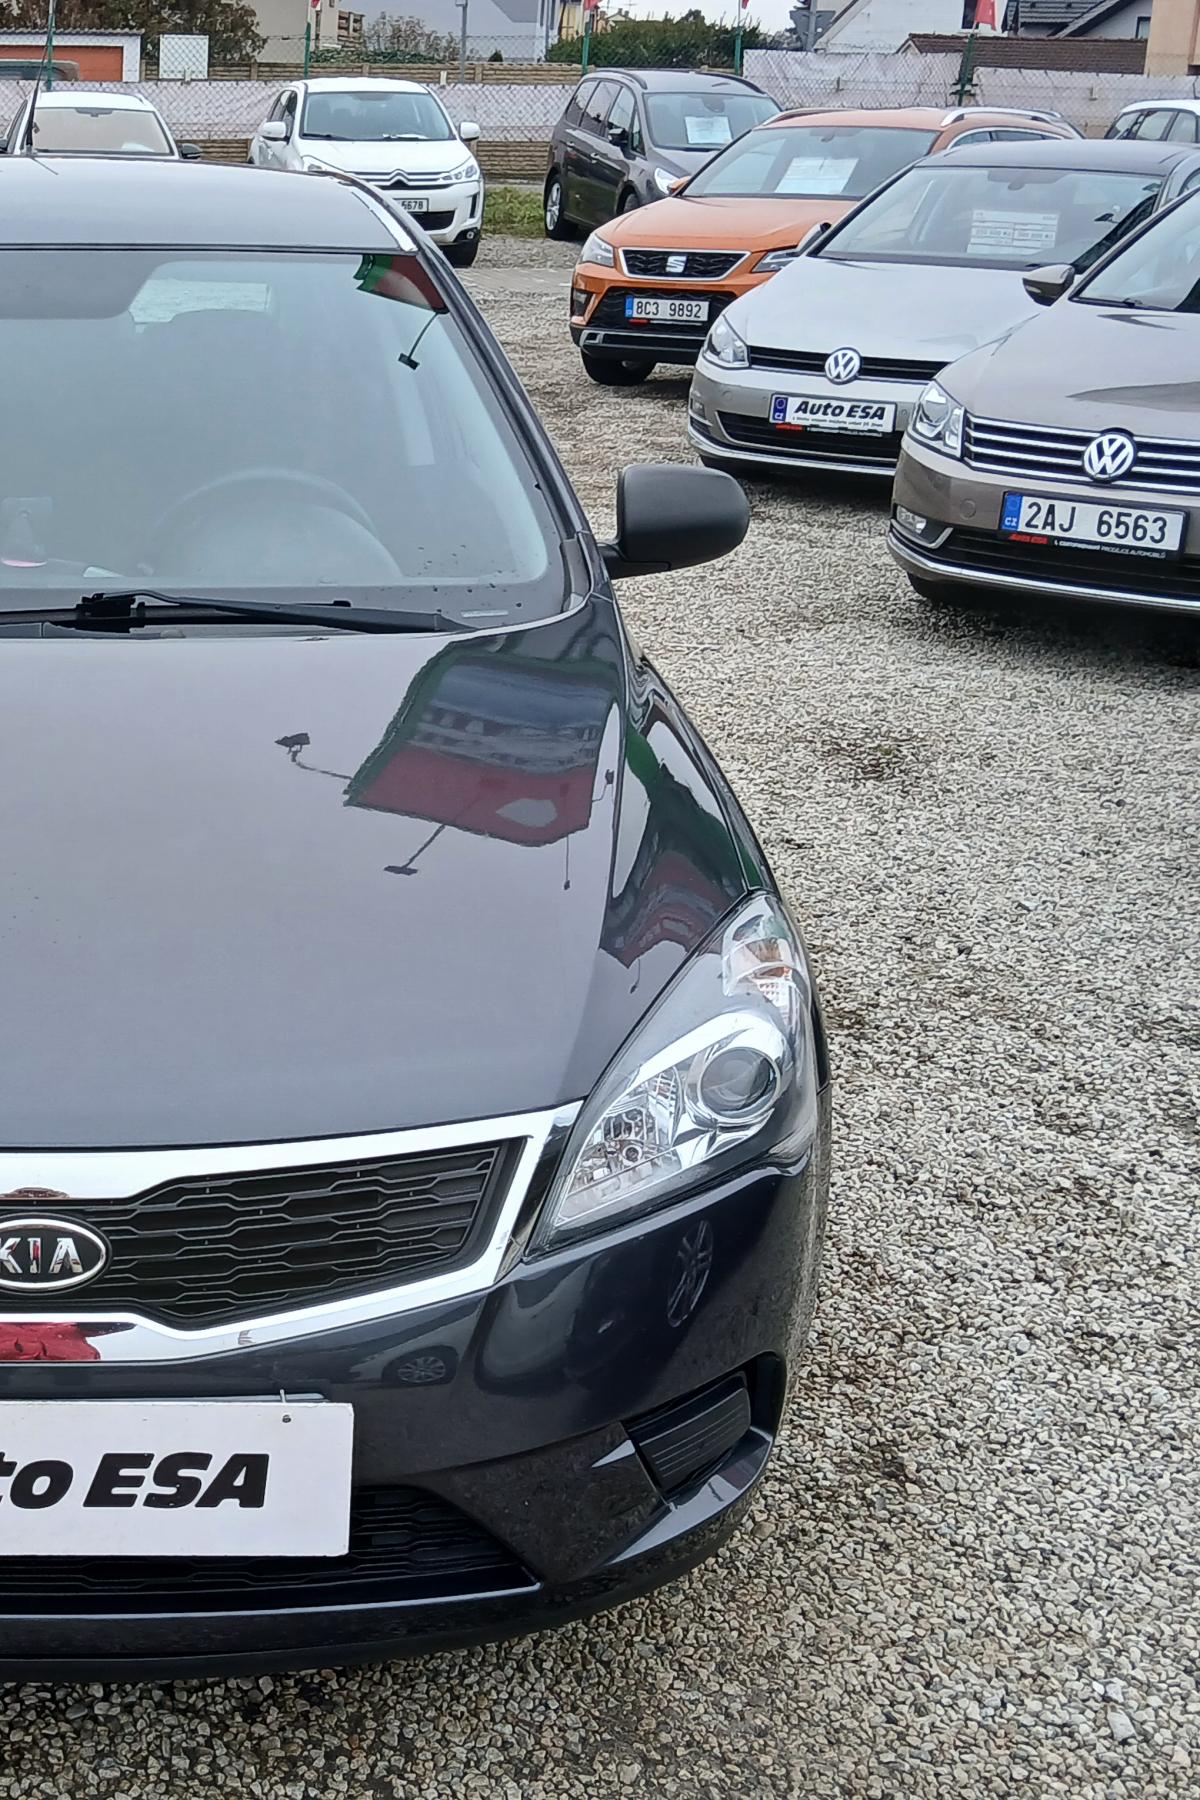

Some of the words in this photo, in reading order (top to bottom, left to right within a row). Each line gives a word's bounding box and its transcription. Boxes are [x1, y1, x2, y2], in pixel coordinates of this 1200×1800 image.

[636, 301, 660, 316] 8C3
[669, 302, 702, 319] 9892
[794, 400, 845, 417] Auto
[846, 404, 886, 420] ESA
[1004, 517, 1017, 527] CZ
[1025, 502, 1077, 533] 2AJ
[1097, 510, 1168, 544] 6563
[82, 1452, 270, 1509] ESA
